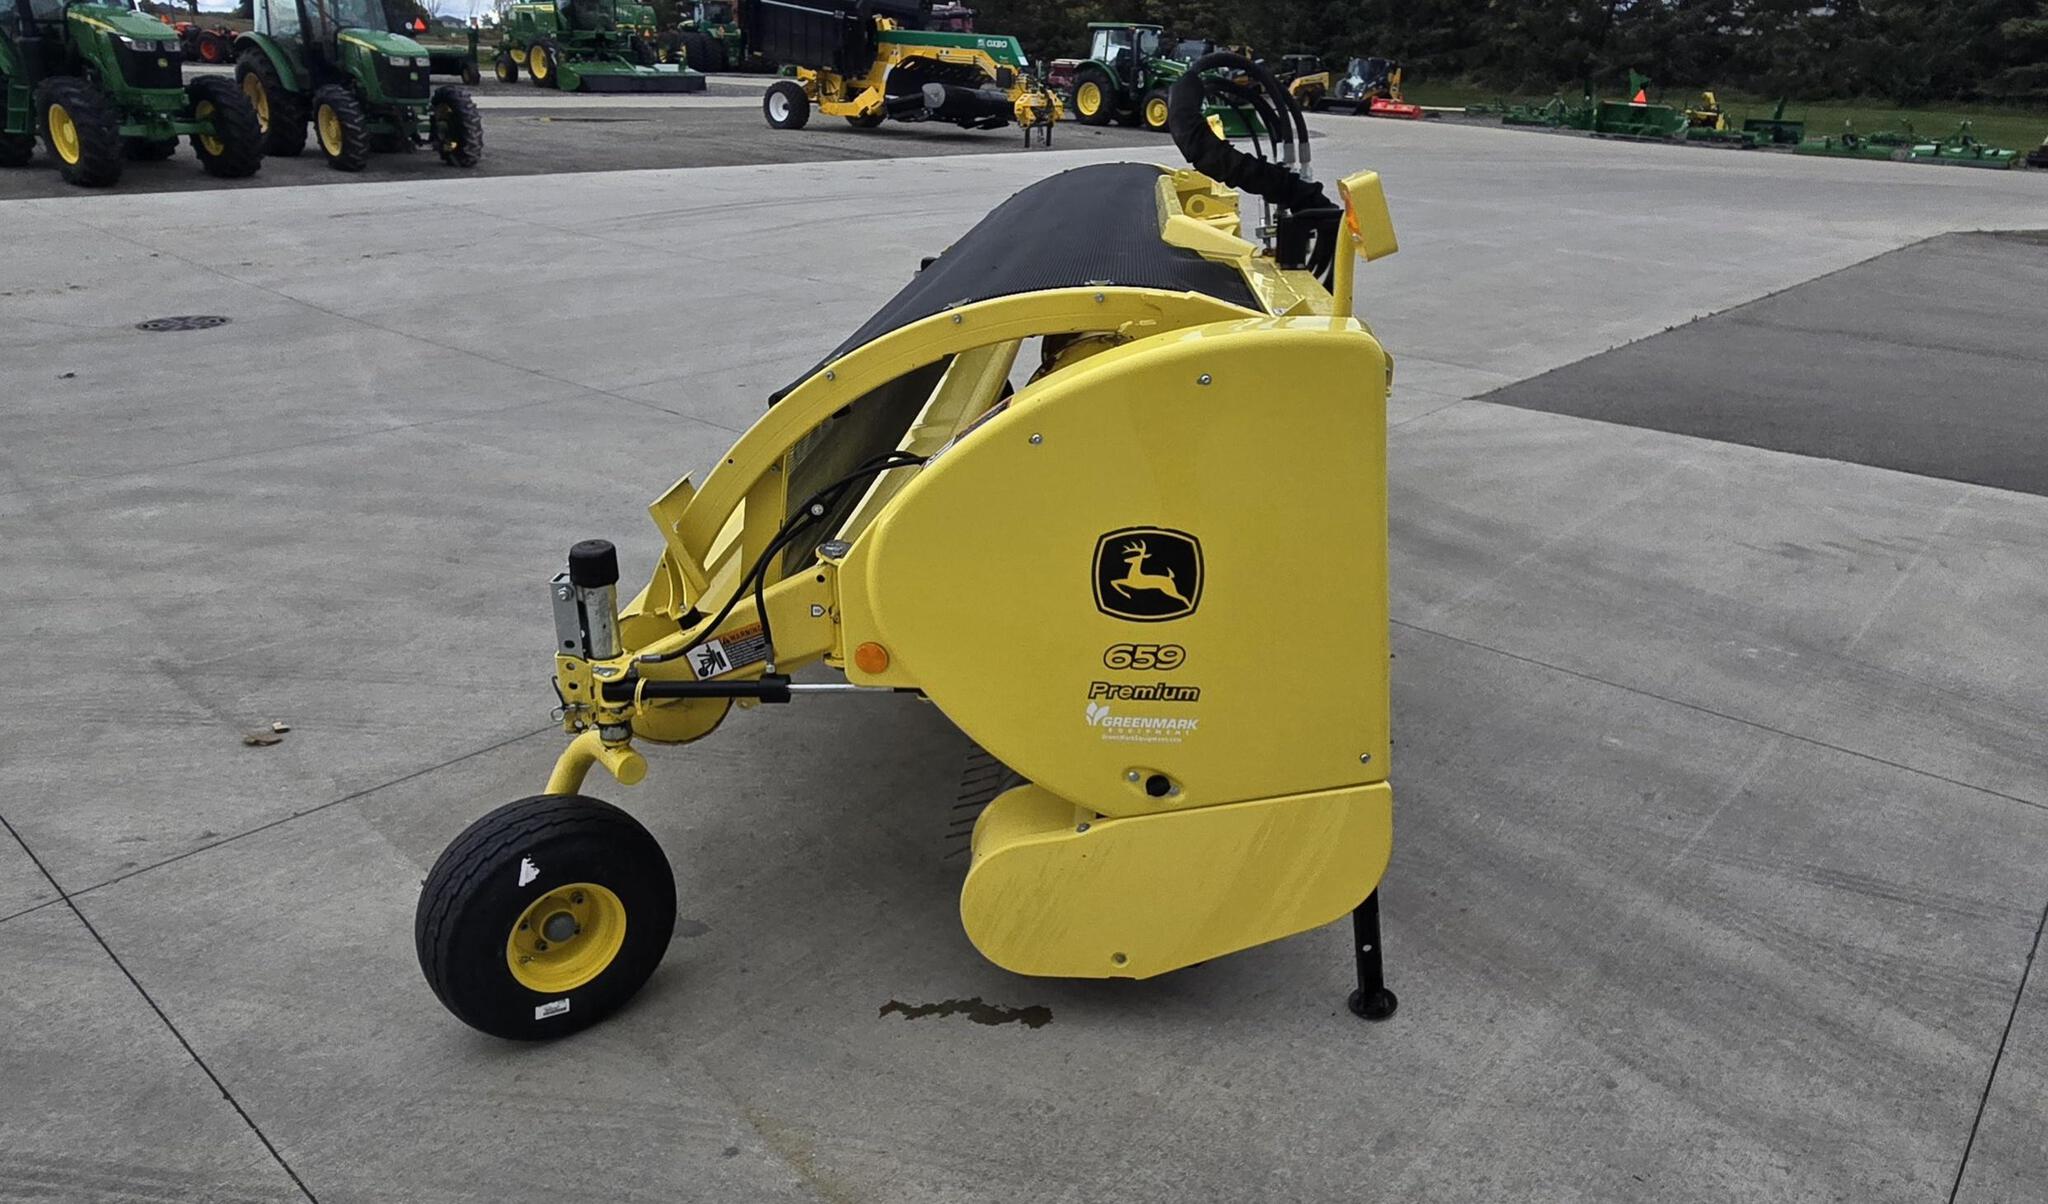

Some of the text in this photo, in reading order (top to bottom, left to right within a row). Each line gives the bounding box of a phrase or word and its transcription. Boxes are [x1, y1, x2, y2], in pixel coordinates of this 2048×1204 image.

[1103, 643, 1186, 670] 659
[1088, 681, 1200, 702] Premium
[1102, 716, 1199, 730] GREENMARK
